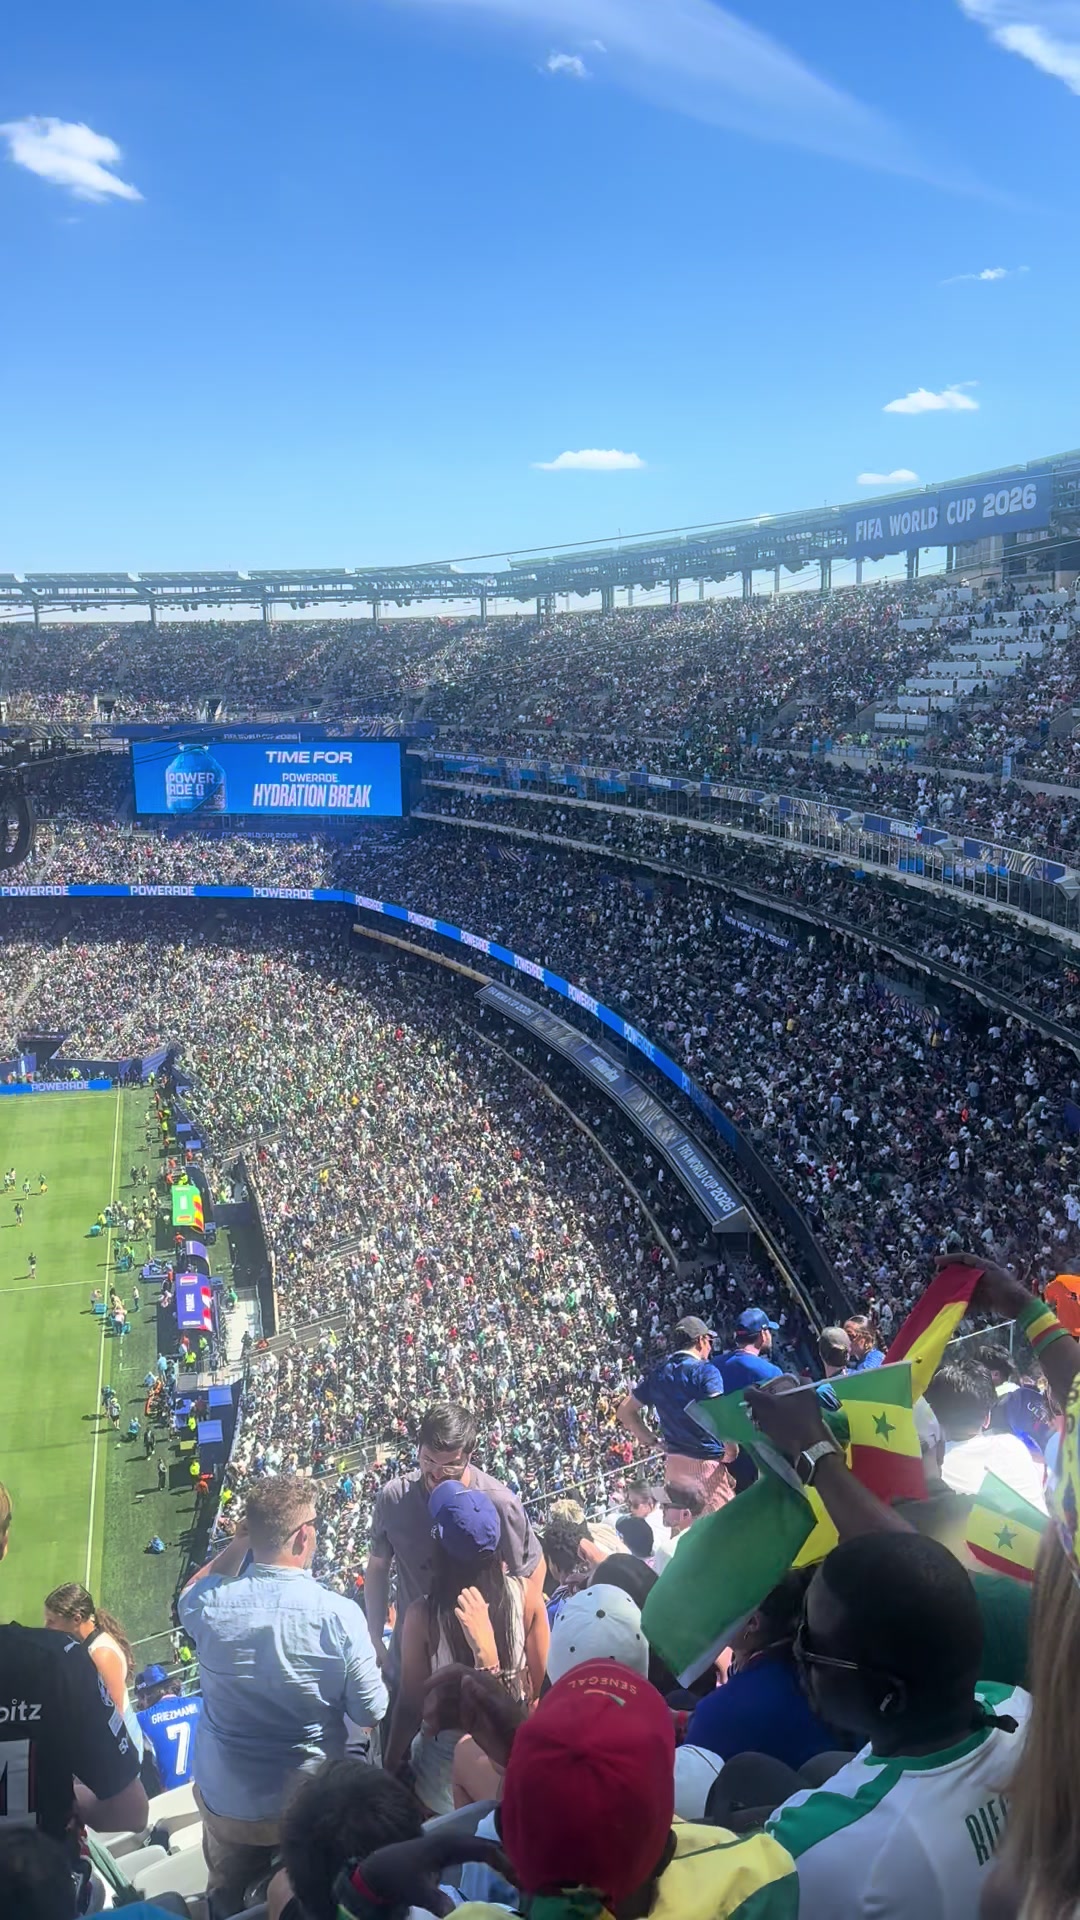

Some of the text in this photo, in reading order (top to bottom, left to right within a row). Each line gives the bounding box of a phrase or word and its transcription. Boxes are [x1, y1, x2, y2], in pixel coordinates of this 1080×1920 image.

[855, 483, 1037, 543] FIFA WORLD CUP 2026
[265, 751, 353, 764] TIME FOR
[168, 772, 215, 784] POWER
[282, 773, 338, 783] POWERADE
[252, 784, 327, 807] HYDRATION
[328, 785, 372, 808] BREAK
[1, 885, 69, 896] POWERADE
[130, 885, 195, 896] POWERADE
[253, 887, 315, 899] POWERADE
[513, 954, 545, 982] POWERADE
[567, 983, 600, 1017] POWERADE
[624, 1021, 655, 1063] POWERADE
[32, 1081, 89, 1092] POWERADE
[677, 1144, 737, 1210] FIFA WORLD CUP 2026
[568, 1676, 637, 1695] SENEGAL
[151, 1703, 198, 1725] GRIEZMANN
[166, 1721, 191, 1776] 7
